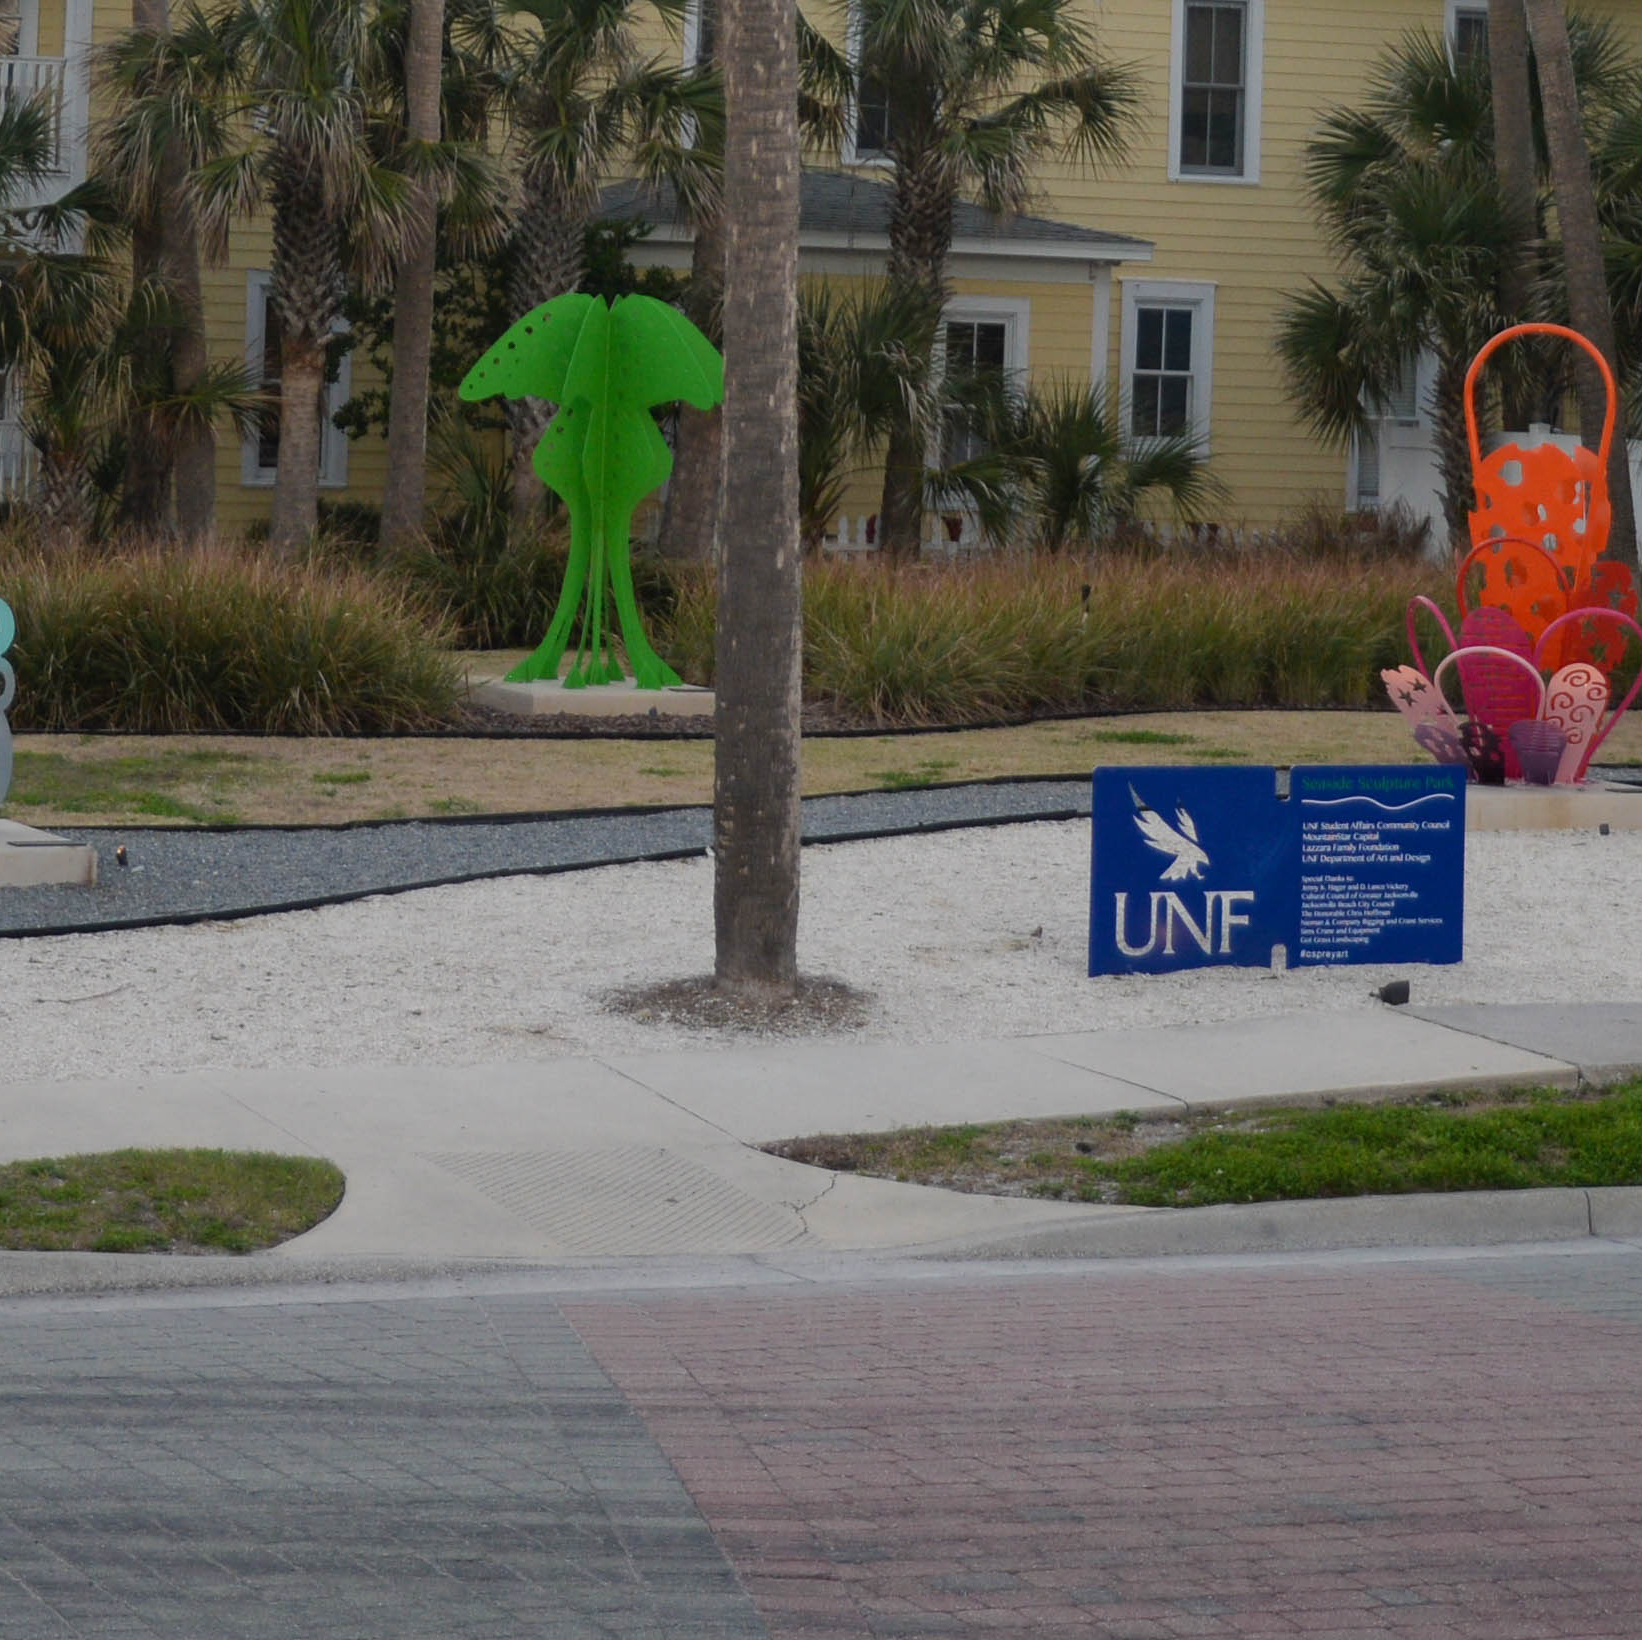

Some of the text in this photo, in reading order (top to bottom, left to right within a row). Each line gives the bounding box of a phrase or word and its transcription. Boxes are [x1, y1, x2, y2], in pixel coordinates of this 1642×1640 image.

[1301, 776, 1454, 790] Seaside Sculpture Park
[1320, 822, 1350, 830] Student
[1350, 821, 1375, 829] Affairs
[1376, 822, 1420, 830] Community
[1421, 821, 1450, 829] Council
[1302, 832, 1380, 841] MountainStar Capital
[1332, 843, 1357, 853] Family
[1358, 843, 1400, 851] Foundation
[1320, 855, 1365, 863] Department
[1366, 853, 1376, 862] of
[1376, 854, 1388, 862] Art
[1404, 854, 1431, 863] Design
[1114, 890, 1255, 957] UNF
[1300, 950, 1349, 959] #ospreyart
